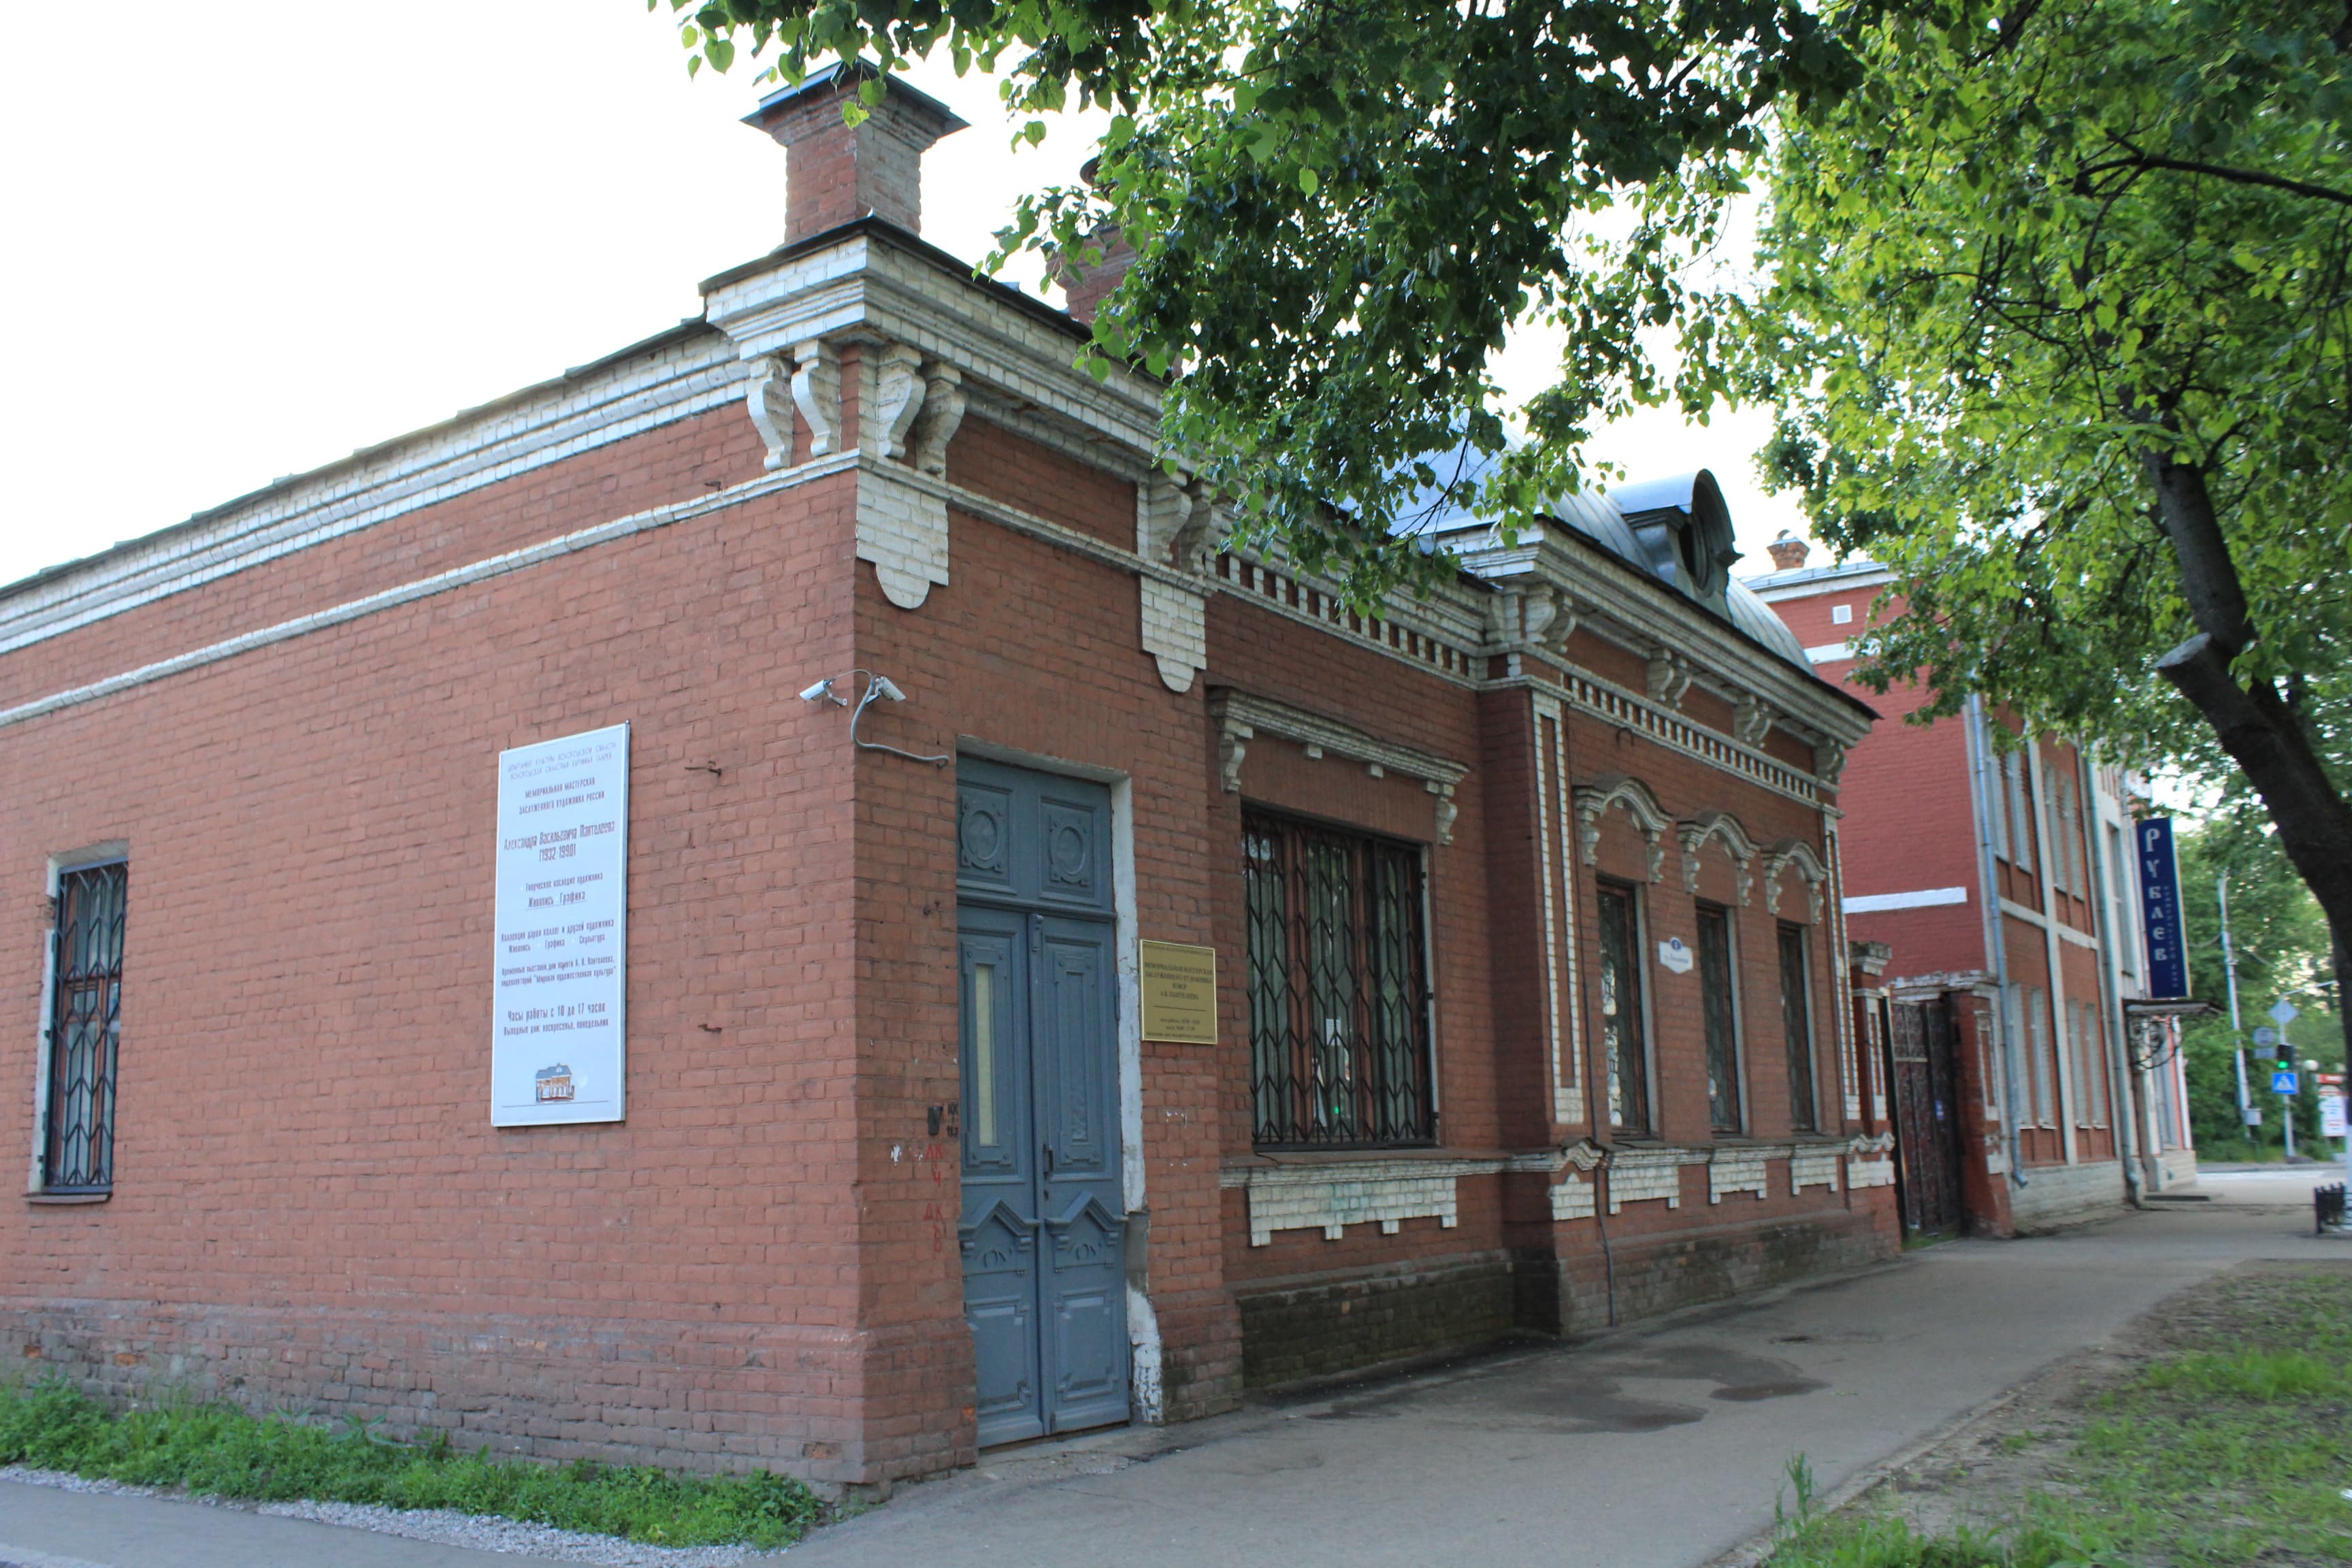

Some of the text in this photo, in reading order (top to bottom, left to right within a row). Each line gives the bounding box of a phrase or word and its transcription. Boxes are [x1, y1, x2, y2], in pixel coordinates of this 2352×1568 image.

[558, 747, 592, 761] ВОЛОГОДСКОЙ
[595, 742, 616, 753] ОБЛАСТИ
[510, 768, 542, 780] ВОЛОГОДСКАЯ
[572, 756, 593, 766] КАРТИННАЯ
[525, 777, 595, 798] МЕМОРИАЛЬНАЯ МАСТЕРСКАЯ
[519, 791, 604, 815] ЗАСЛУЖЕННОГО ХУДОЖНИКА РОССИИ
[504, 821, 615, 850] Александра Васильевича Пантелеева
[526, 872, 603, 892] Творческое наследие художника
[528, 891, 585, 907] Живопись Графика
[501, 932, 525, 942] Коллекция
[527, 930, 542, 939] даров
[543, 927, 559, 936] коллег
[567, 921, 584, 934] друзей
[587, 919, 614, 932] художника
[508, 934, 605, 953] Живопись Графика Скульптура
[502, 966, 525, 976] Временные
[557, 961, 573, 970] памяти
[575, 958, 579, 966] А.
[587, 956, 614, 965] Пантелеева,
[557, 970, 591, 981] художественная
[593, 966, 616, 977] культура"
[508, 1002, 605, 1022] Часы работы с 10 до 17 часов
[504, 1026, 528, 1036] Выходные
[542, 1022, 575, 1033] воскресенье,
[576, 1019, 608, 1028] понедельник
